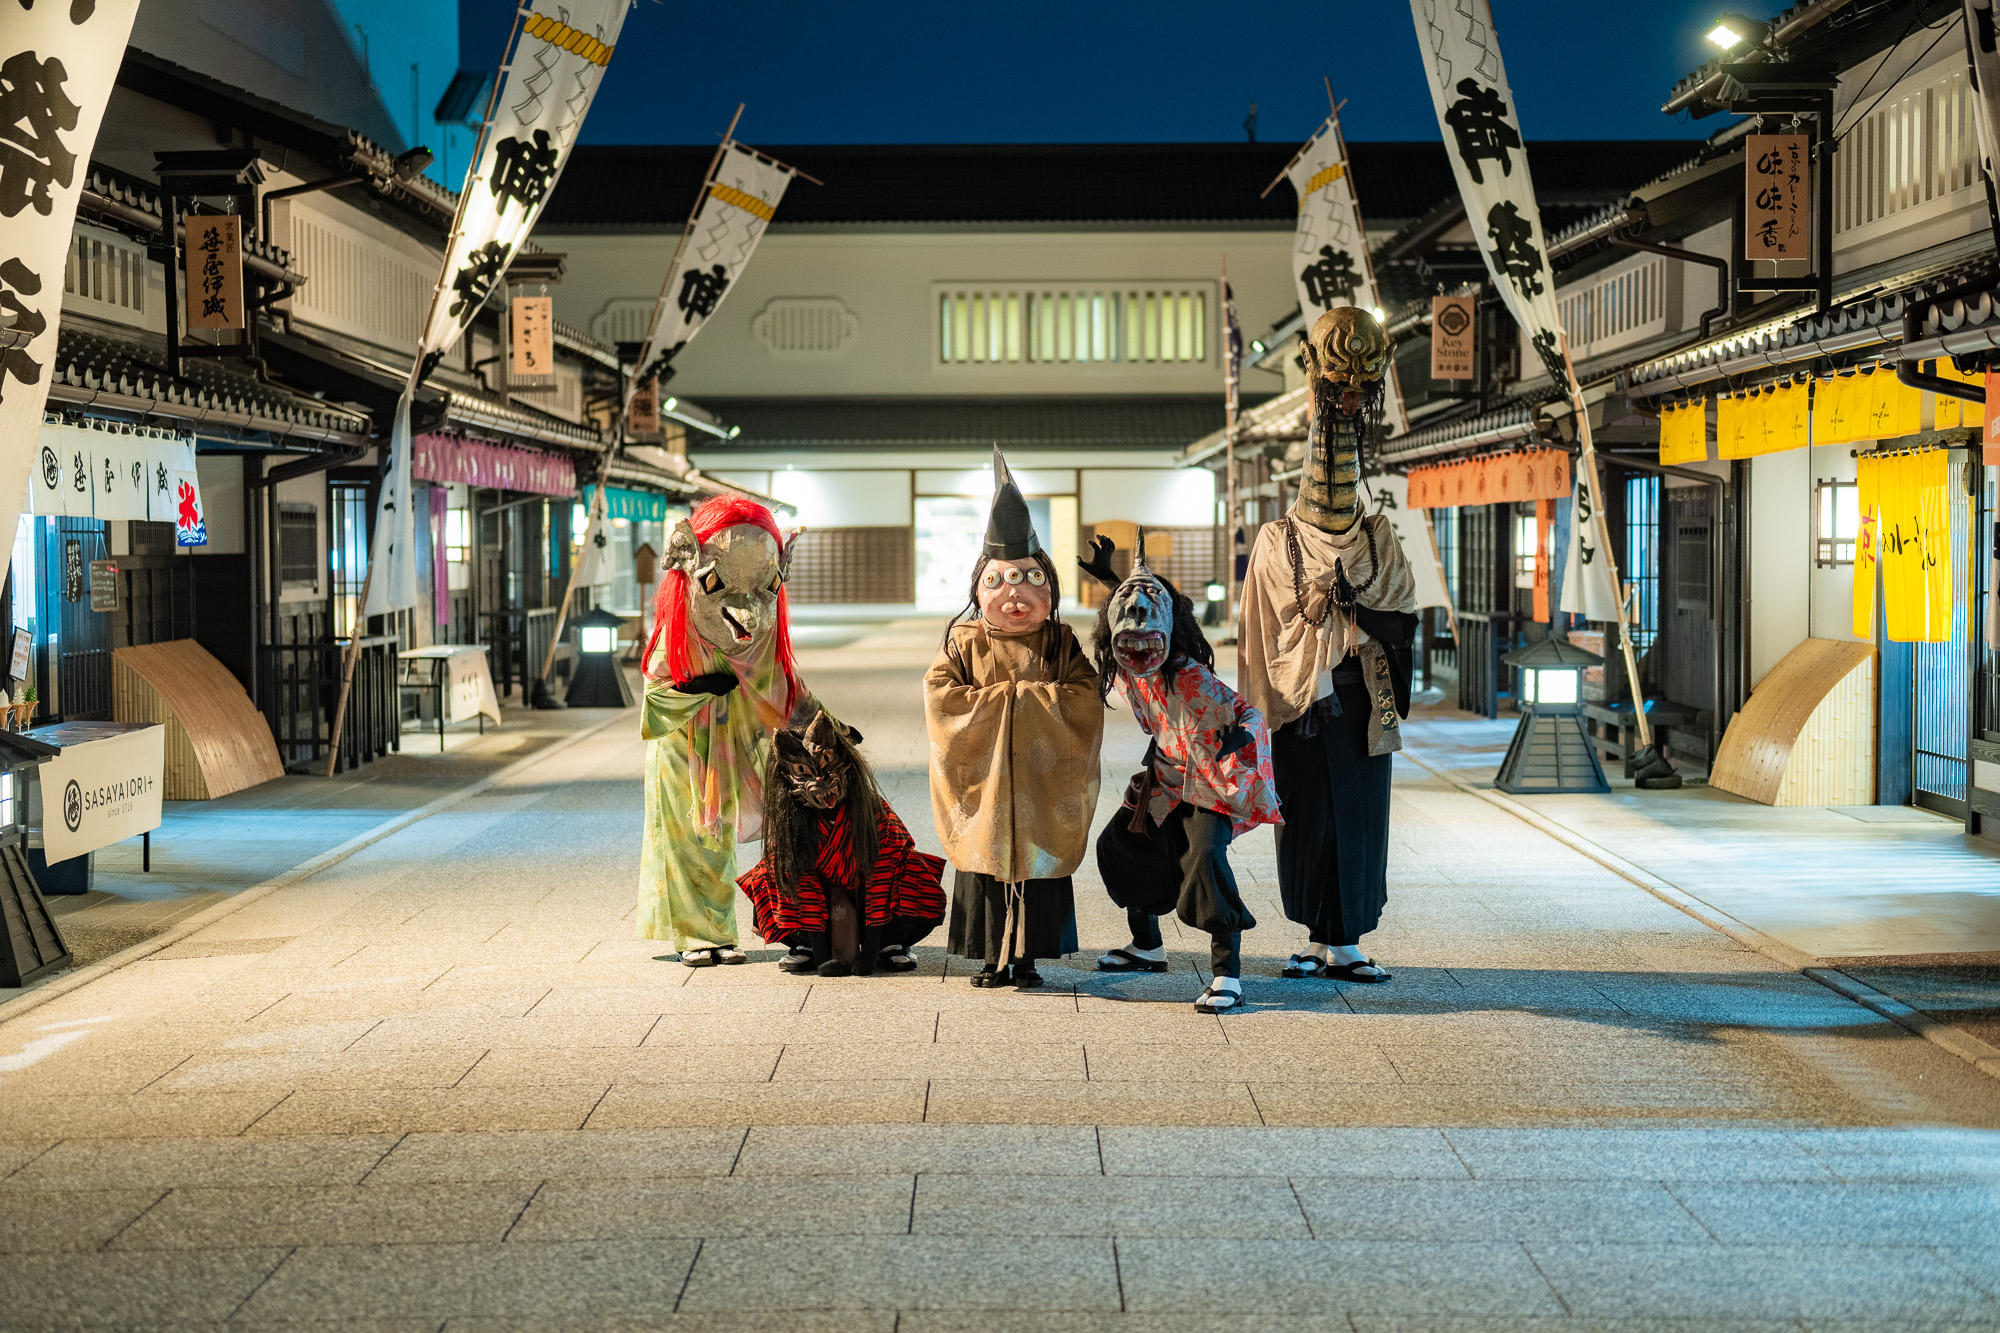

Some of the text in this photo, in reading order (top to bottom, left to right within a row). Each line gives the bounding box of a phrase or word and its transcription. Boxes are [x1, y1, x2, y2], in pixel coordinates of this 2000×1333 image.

[1755, 146, 1784, 249] 味味香
[224, 221, 235, 254] 京菓匠
[198, 226, 229, 324] 笹屋伊織
[1437, 348, 1470, 358] Stone
[1442, 337, 1463, 348] Key
[107, 801, 133, 818] since 1716
